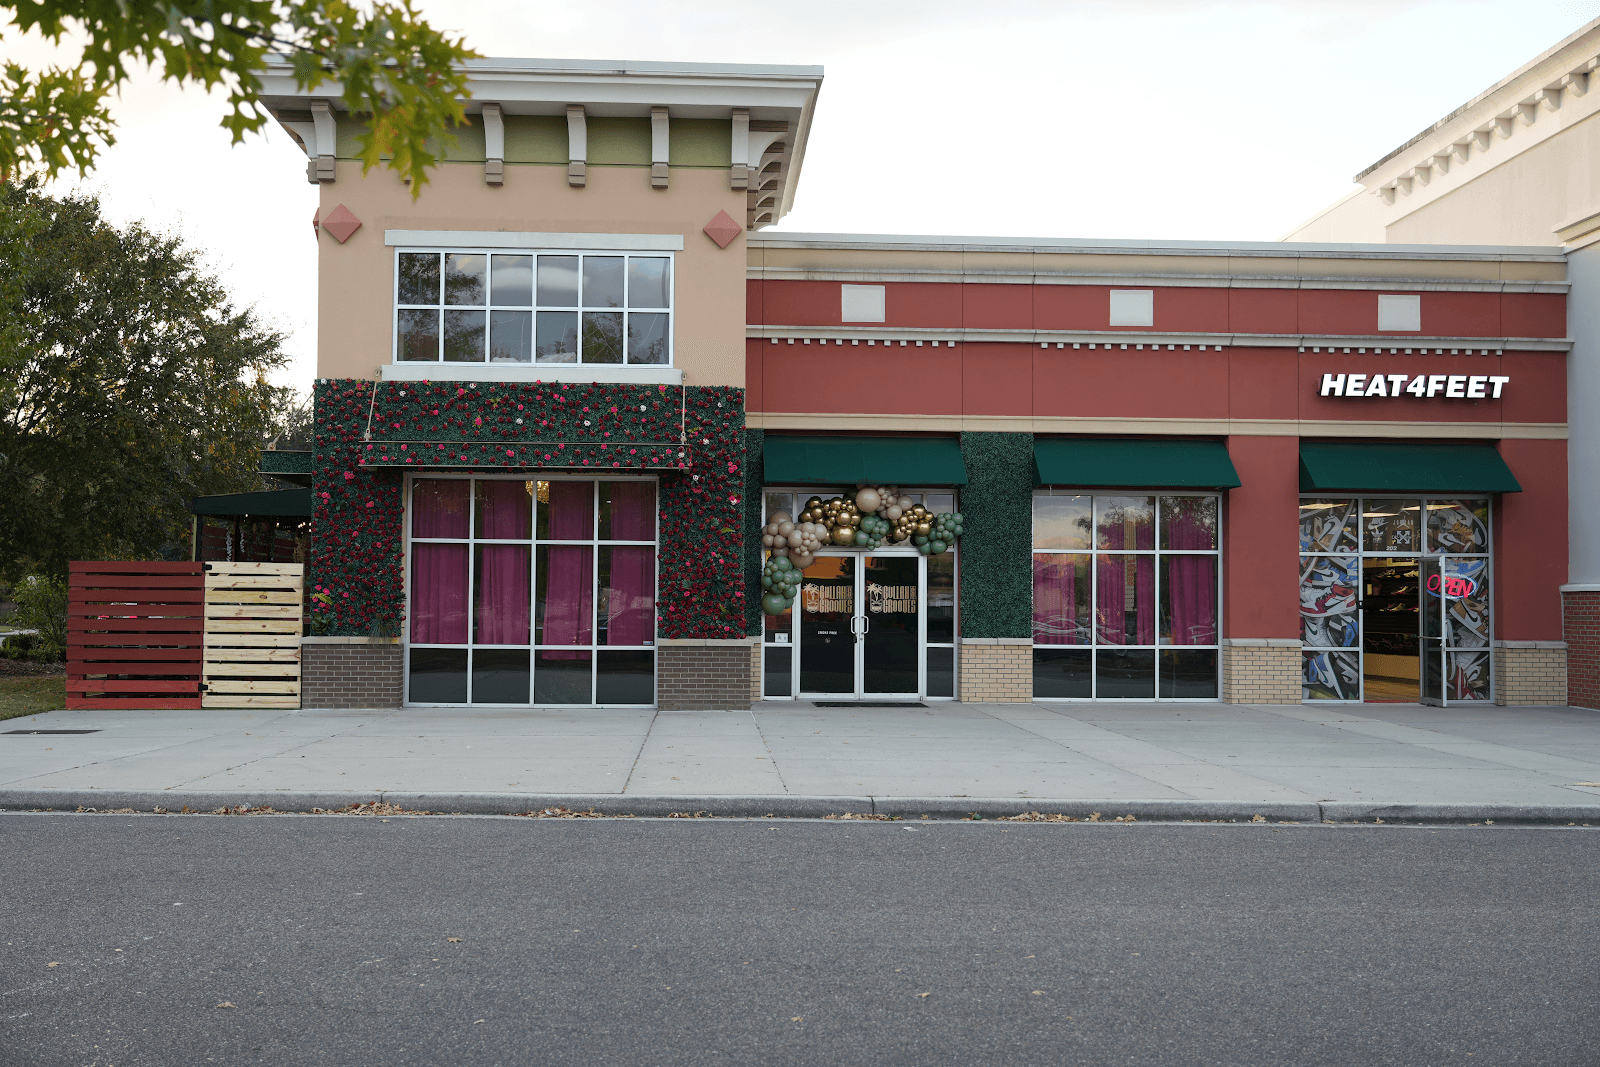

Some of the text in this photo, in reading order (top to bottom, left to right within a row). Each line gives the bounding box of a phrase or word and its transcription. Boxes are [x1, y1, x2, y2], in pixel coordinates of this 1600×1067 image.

[1320, 373, 1510, 399] HEAT4FEET
[1426, 574, 1474, 599] OPEN
[819, 599, 853, 614] GROOVES
[883, 599, 917, 614] GROOVES
